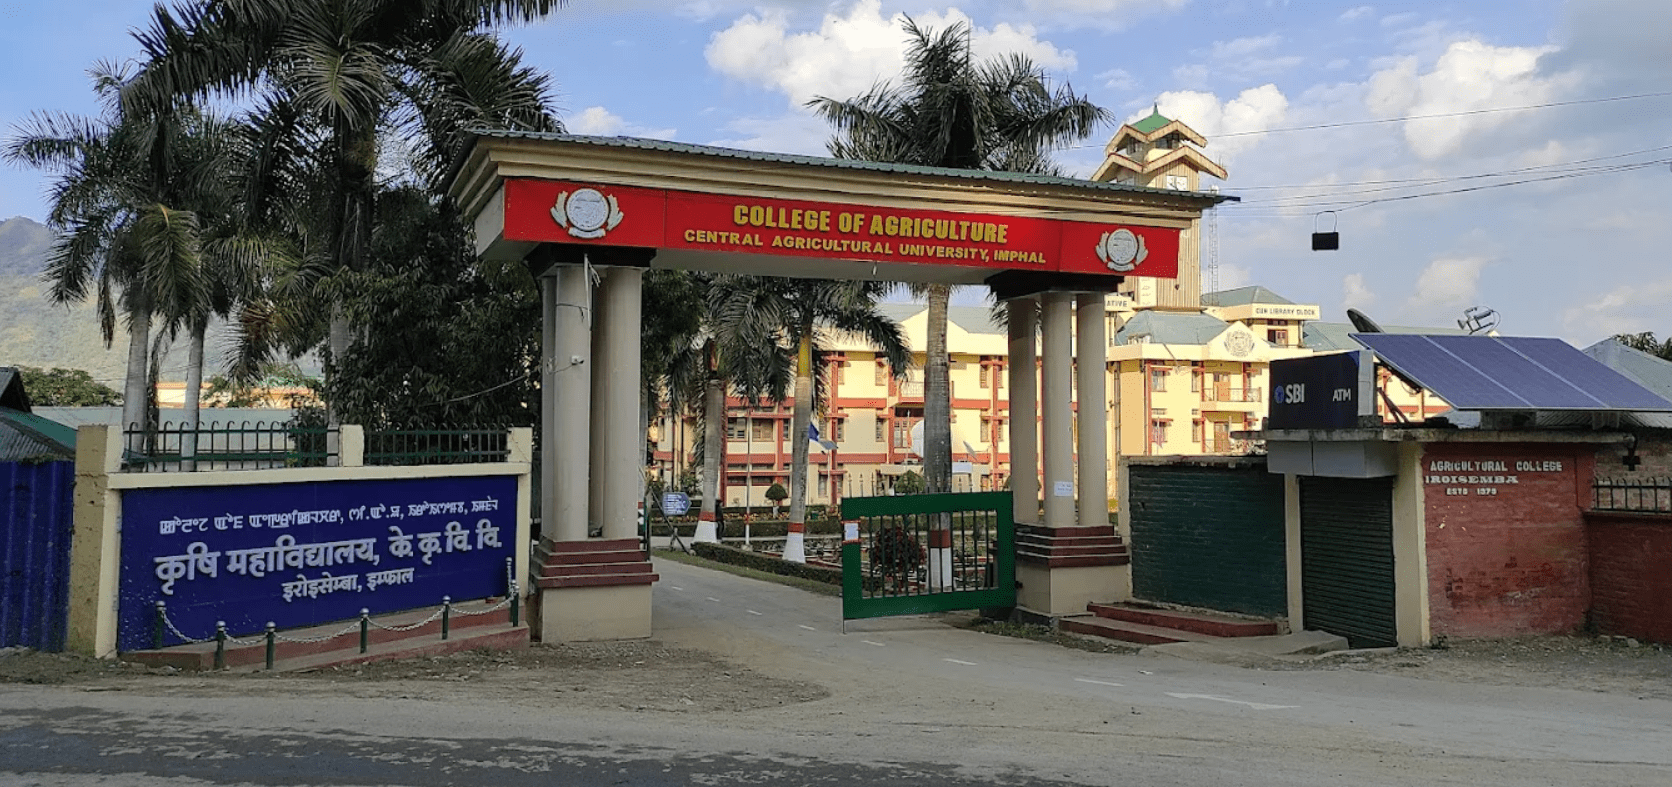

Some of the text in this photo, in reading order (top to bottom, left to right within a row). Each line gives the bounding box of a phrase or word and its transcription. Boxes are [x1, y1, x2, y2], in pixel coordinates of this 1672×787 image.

[734, 205, 1009, 243] COLLEGE OF AGRICULTURE
[684, 229, 1047, 264] CENTRAL AGRICULTURAL UNIVERSITY, IMPHAL
[1285, 383, 1352, 404] SBI ATM
[1425, 475, 1519, 484] IROISEMBA
[1430, 460, 1562, 472] AGRICULTURAL COLLEGE
[153, 541, 221, 595] कृषि
[225, 534, 380, 578] महाविद्यालय,
[281, 567, 415, 603] इरोइसेम्बा, इम्फाल
